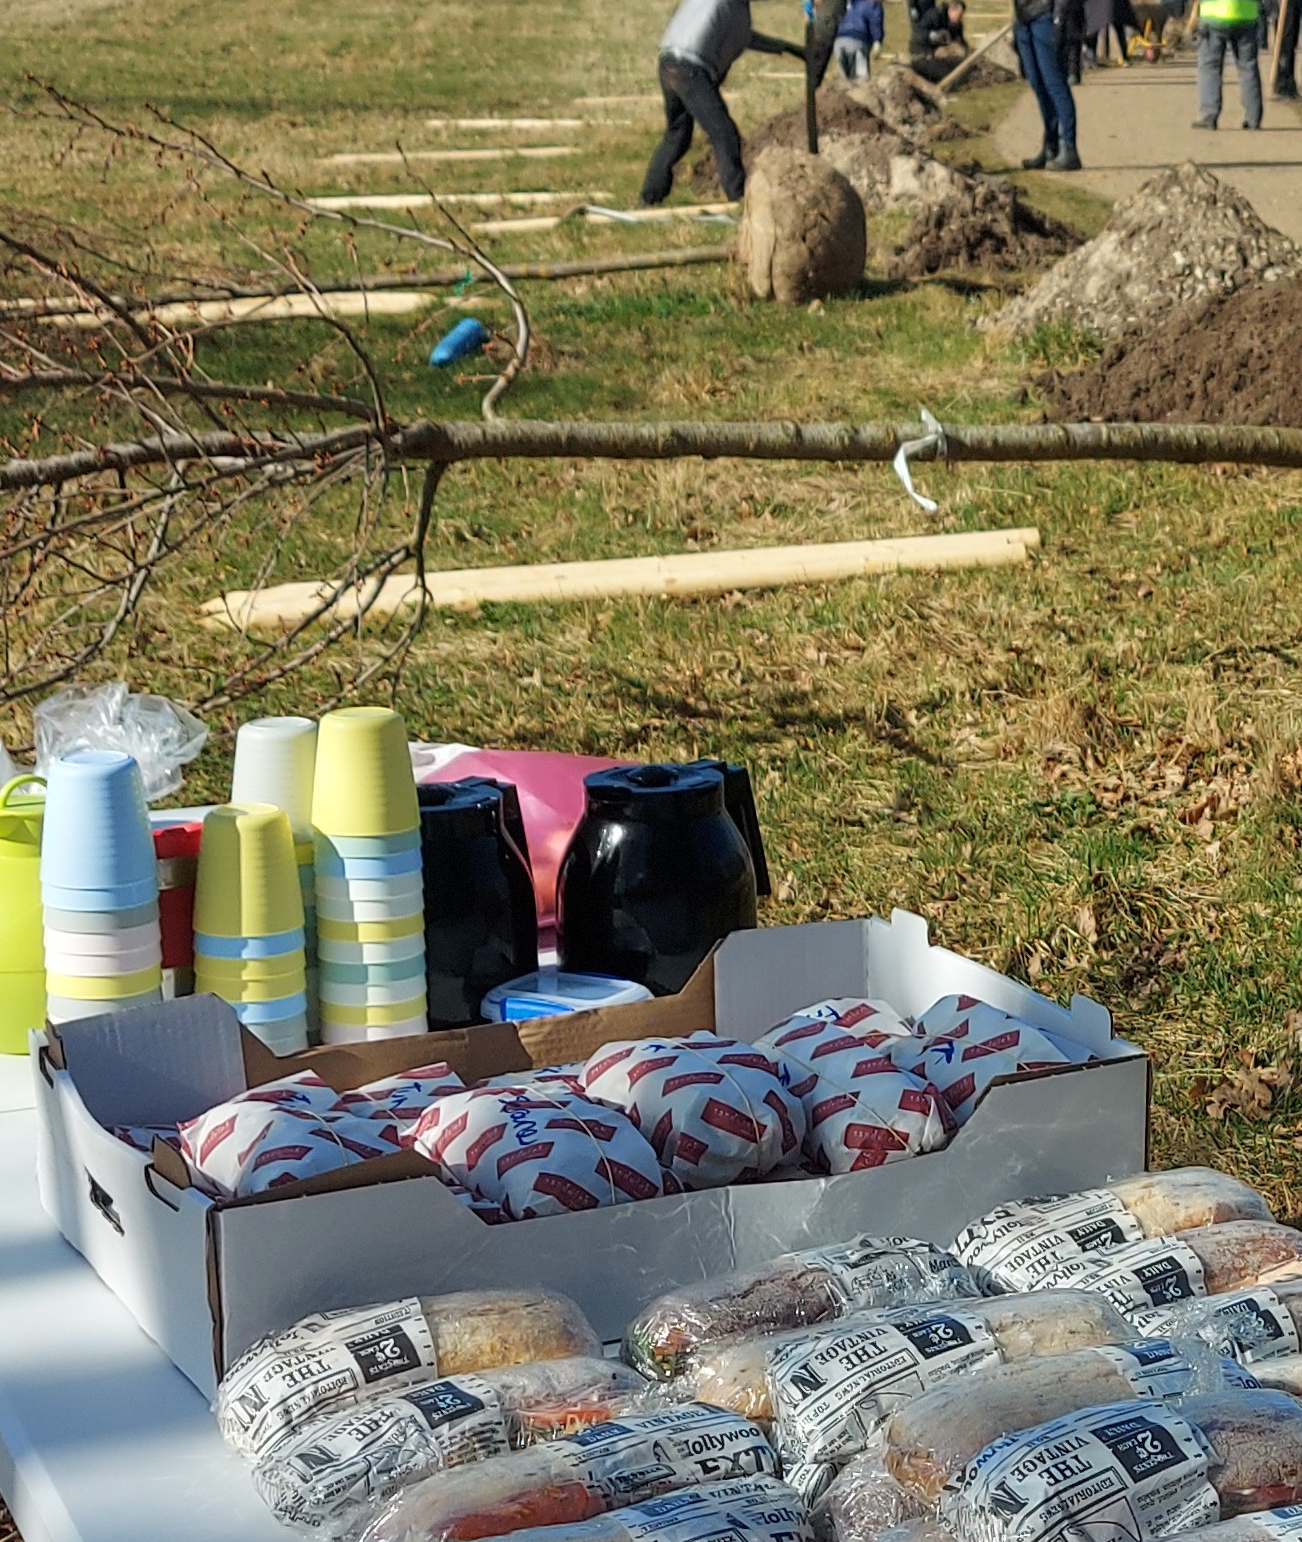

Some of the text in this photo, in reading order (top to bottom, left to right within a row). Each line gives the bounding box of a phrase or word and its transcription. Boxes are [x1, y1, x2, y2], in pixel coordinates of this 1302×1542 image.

[1005, 1235, 1065, 1272] VINTAGE
[1142, 1260, 1172, 1278] DAILY
[815, 1327, 889, 1364] VINTAGE
[839, 1342, 888, 1371] THE
[285, 1359, 332, 1389] THE
[350, 1409, 395, 1443] THE
[1011, 1435, 1091, 1483] VINTAGE
[1038, 1455, 1094, 1487] THE
